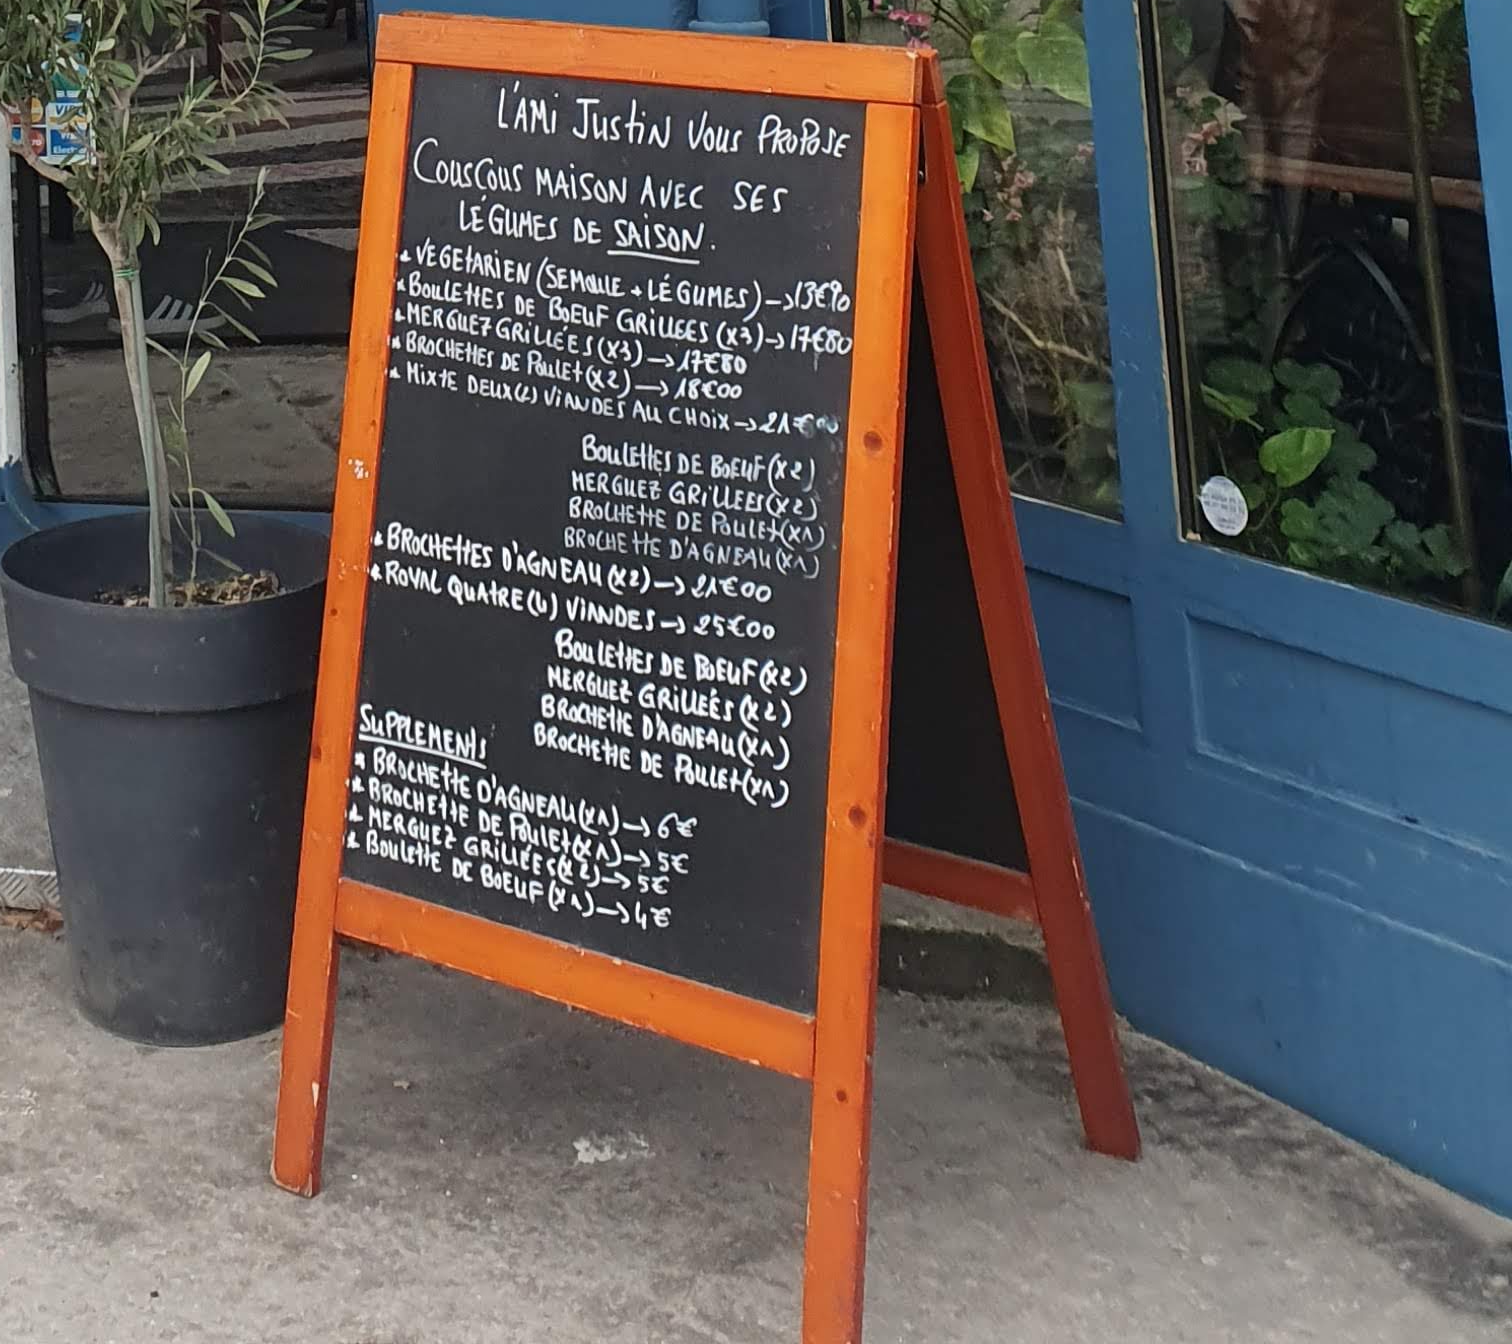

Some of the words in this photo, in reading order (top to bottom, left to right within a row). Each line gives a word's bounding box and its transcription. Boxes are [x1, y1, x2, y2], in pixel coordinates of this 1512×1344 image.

[758, 114, 851, 158] PROPOSE
[536, 163, 628, 204] MAISON
[640, 175, 704, 209] AVEC
[733, 180, 788, 213] SES
[459, 194, 558, 241] LÉGUMES
[573, 217, 602, 244] DE
[407, 302, 492, 337] MERGUEZ
[515, 295, 535, 317] DE
[549, 296, 609, 328] BOEUF
[501, 352, 520, 372] DE
[633, 399, 662, 424] AU
[669, 407, 730, 431] CHOIX
[677, 453, 704, 475] DE
[676, 511, 703, 533] DE
[385, 561, 442, 594] ROYAL
[659, 652, 687, 679] DE
[640, 750, 664, 779] DE
[478, 808, 504, 837] DE
[657, 851, 689, 873] 5€
[452, 857, 473, 882] DE
[480, 864, 545, 904] BOEUF
[637, 875, 670, 895] 5€
